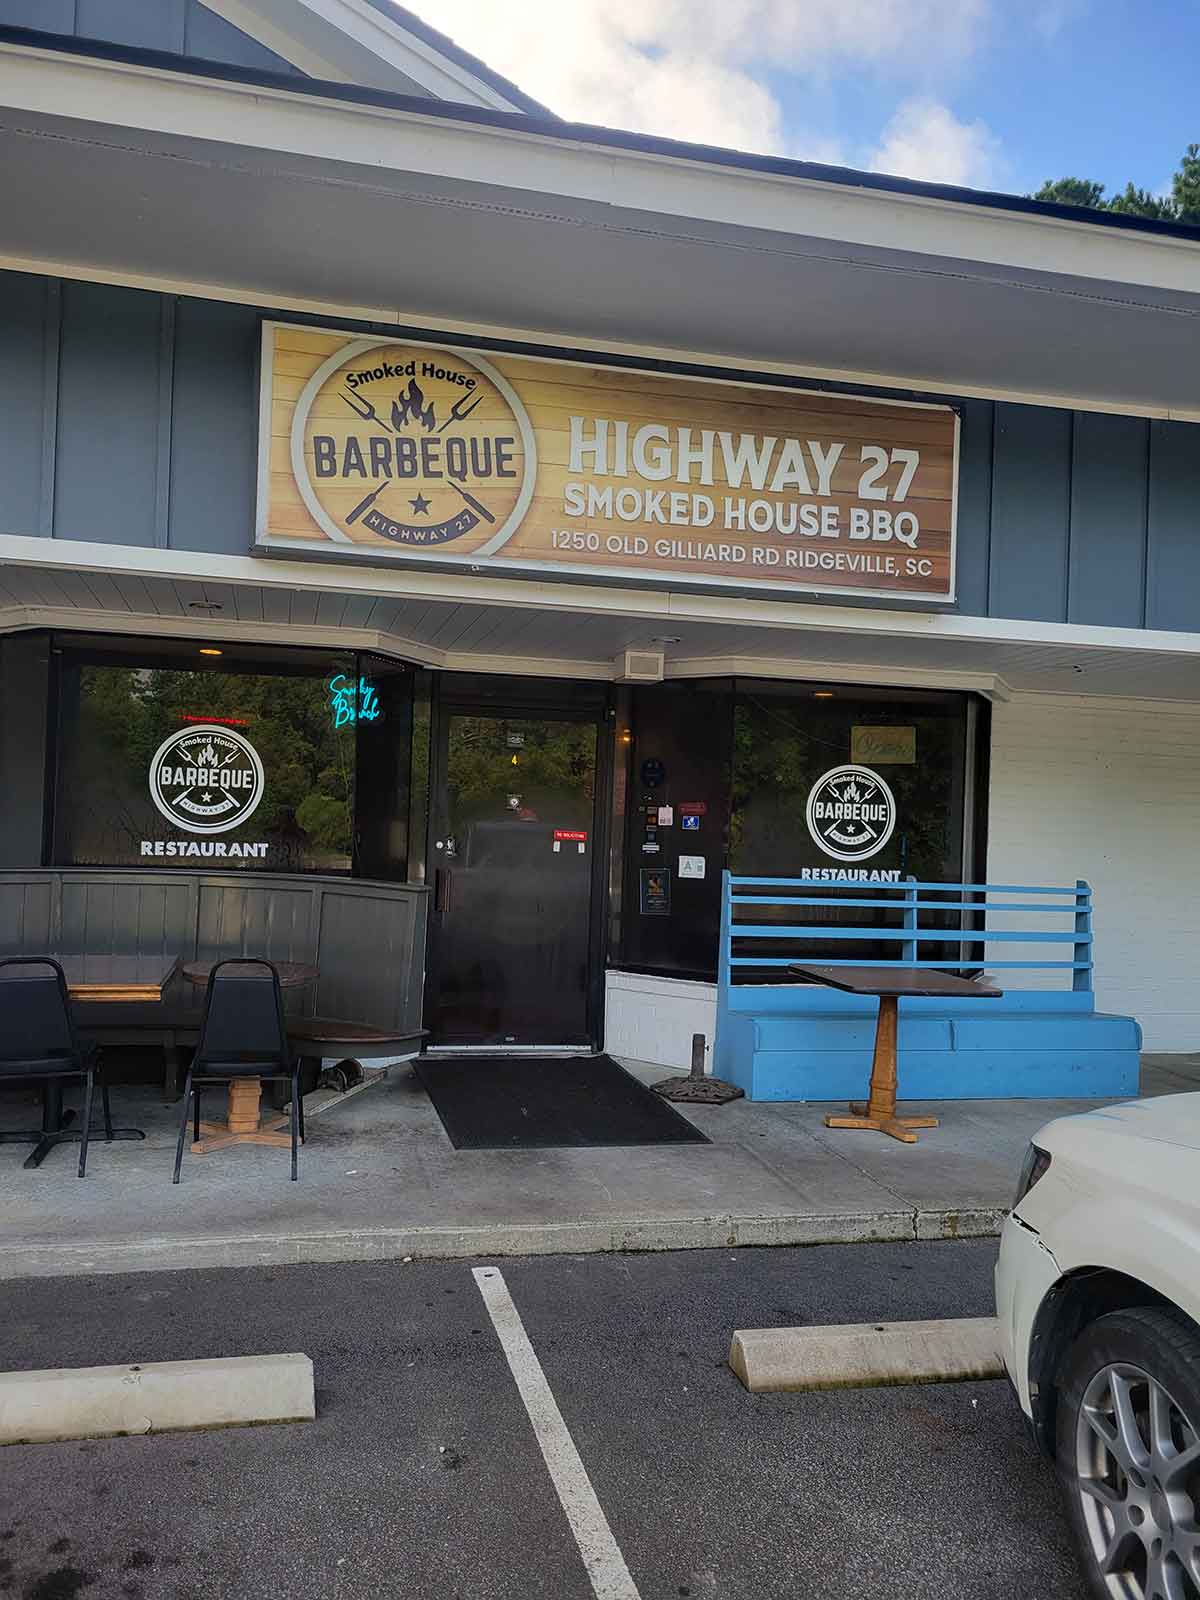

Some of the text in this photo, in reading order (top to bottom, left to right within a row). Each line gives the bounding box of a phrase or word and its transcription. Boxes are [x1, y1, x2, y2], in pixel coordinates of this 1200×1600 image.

[346, 360, 477, 390] Smoked House
[312, 435, 517, 482] BARBEQUE
[567, 415, 921, 503] HIGHWAY 27
[369, 513, 473, 542] HIGHWAY 27
[563, 482, 920, 549] SMOKED HOUSE BBQ
[551, 529, 933, 577] 1250 OLD GILLIARD RD RIDGEVILLE, SC
[179, 735, 239, 751] Smoked House
[161, 766, 253, 790] BARBEQUE
[829, 774, 855, 786] Smoked
[815, 801, 887, 823] BARBEQUE
[140, 840, 269, 858] RESTAURANT
[801, 867, 902, 883] RESTAURANT
